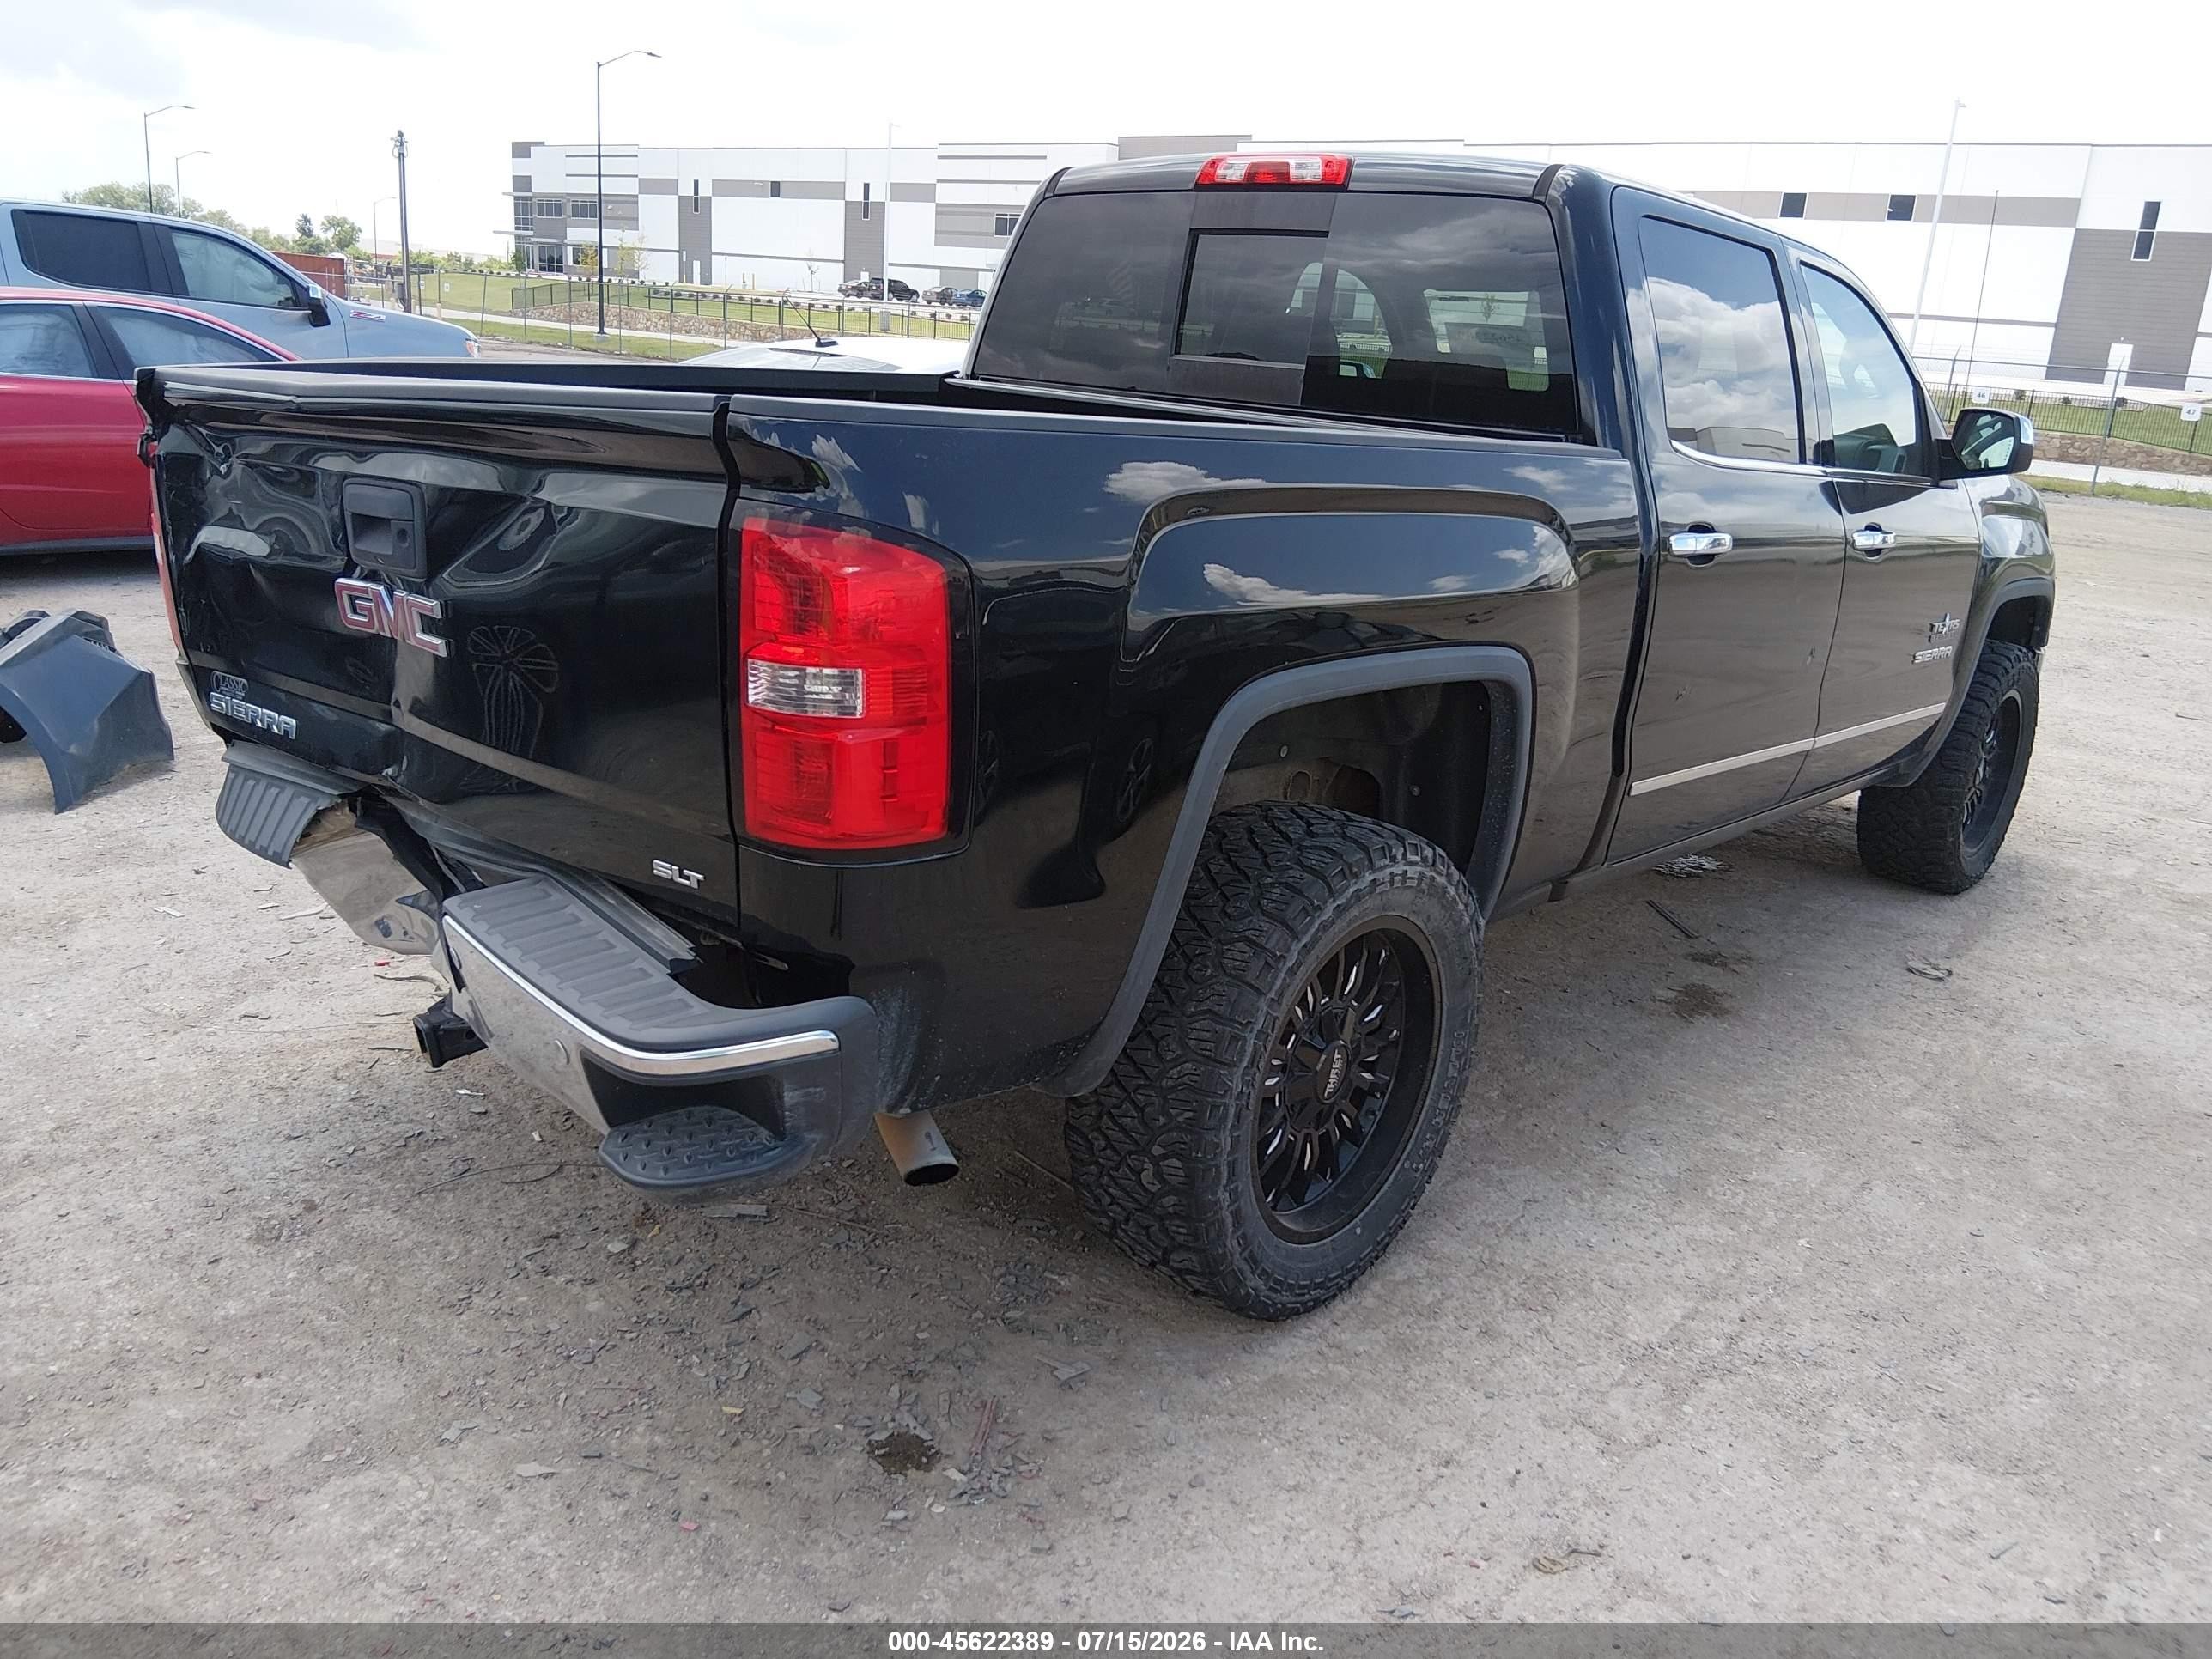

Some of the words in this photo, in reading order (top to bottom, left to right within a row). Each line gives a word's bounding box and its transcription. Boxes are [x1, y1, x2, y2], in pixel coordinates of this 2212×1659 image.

[335, 578, 448, 658] GMC
[1913, 646, 1953, 664] SIERRA
[212, 671, 249, 693] CLASSIC
[210, 691, 297, 739] SIERRA
[653, 860, 704, 889] SLT
